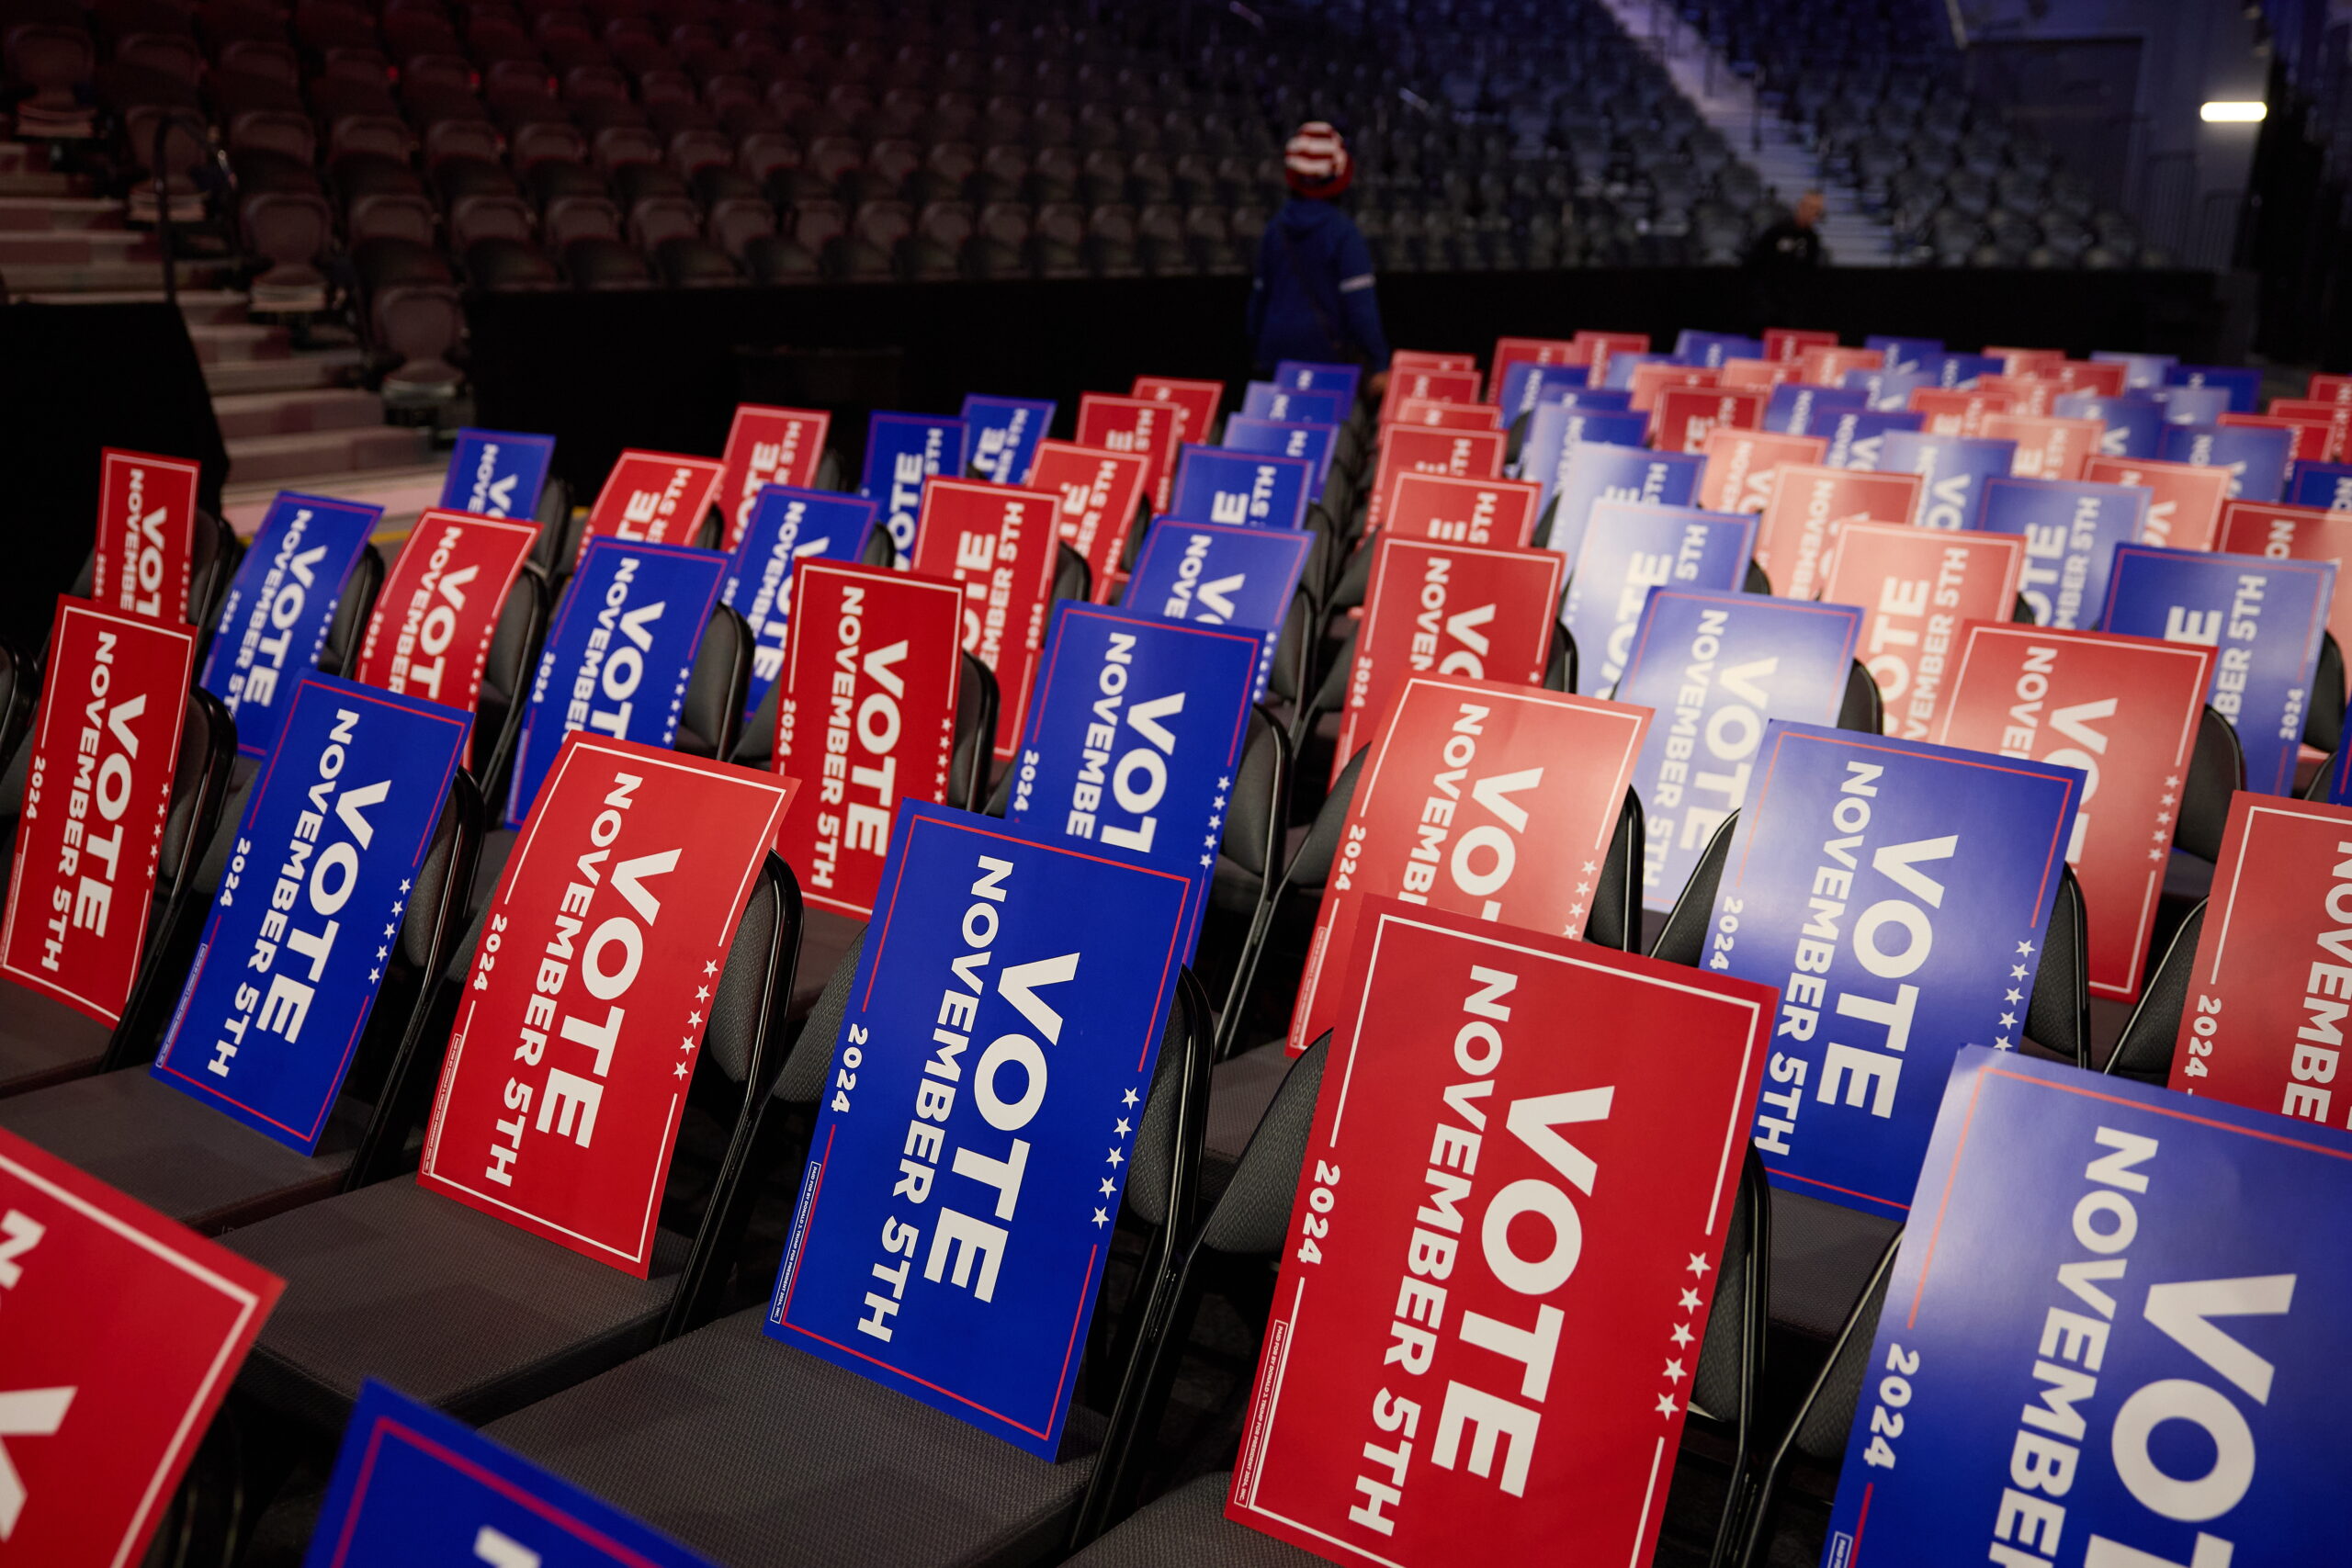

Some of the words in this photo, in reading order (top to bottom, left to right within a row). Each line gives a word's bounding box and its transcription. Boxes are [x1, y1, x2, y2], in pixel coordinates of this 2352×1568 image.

[120, 468, 144, 612] NOVEMBE
[136, 506, 167, 617] VOT
[236, 509, 313, 671] NOVEMBER
[980, 567, 1013, 672] EMBER
[997, 502, 1024, 561] 5TH
[1163, 535, 1212, 619] NOVE
[1675, 524, 1709, 581] 5TH
[2227, 574, 2267, 642] 5TH
[223, 676, 243, 713] 5T
[243, 545, 328, 707] VOTE
[410, 564, 479, 699] VOT
[590, 601, 666, 740] VOT
[820, 586, 865, 805] NOVEMBER
[1903, 614, 1955, 740] VEMBER
[1934, 547, 1970, 608] 5TH
[58, 631, 117, 878] NOVEMBER
[779, 698, 797, 757] 2024
[844, 639, 909, 857] VOTE
[1065, 632, 1137, 840] NOVEMBE
[1100, 692, 1186, 853] VOT
[1653, 609, 1728, 808] NOVEMBER
[1679, 656, 1780, 851] VOTE
[1998, 646, 2058, 760] NOVE
[26, 757, 47, 820] 2024
[73, 694, 147, 938] VOTE
[247, 708, 359, 976] NOVEMBER
[811, 815, 841, 889] 5TH
[1014, 750, 1040, 812] 2024
[1397, 703, 1490, 906] NOVEMB
[1451, 767, 1544, 922] VO
[1643, 816, 1674, 888] 5TH
[41, 885, 74, 974] 5TH
[220, 838, 251, 908] 2024
[256, 779, 391, 1043] VOTE
[514, 772, 643, 1066] NOVEMBER
[1334, 824, 1365, 891] 2024
[1778, 761, 1884, 1042] NOVEMBER
[473, 914, 508, 991] 2024
[536, 848, 683, 1148] VOTE
[1710, 896, 1744, 970] 2024
[1816, 834, 1959, 1119] VOTE
[208, 980, 262, 1077] 5TH
[831, 1023, 868, 1113] 2024
[892, 855, 1013, 1204] NOVEMBER
[2184, 995, 2222, 1077] 2024
[485, 1077, 534, 1187] 5TH
[922, 952, 1081, 1303] VOTE
[1383, 964, 1519, 1376] NOVEMBER
[1754, 1052, 1808, 1156] 5TH
[857, 1215, 920, 1343] 5TH
[1296, 1159, 1340, 1266] 2024
[1430, 1085, 1615, 1498] VOTE
[1989, 1125, 2159, 1568] NOVEMBE
[1348, 1386, 1421, 1537] 5TH
[1863, 1343, 1920, 1470] 2024
[2084, 1273, 2297, 1568] VO
